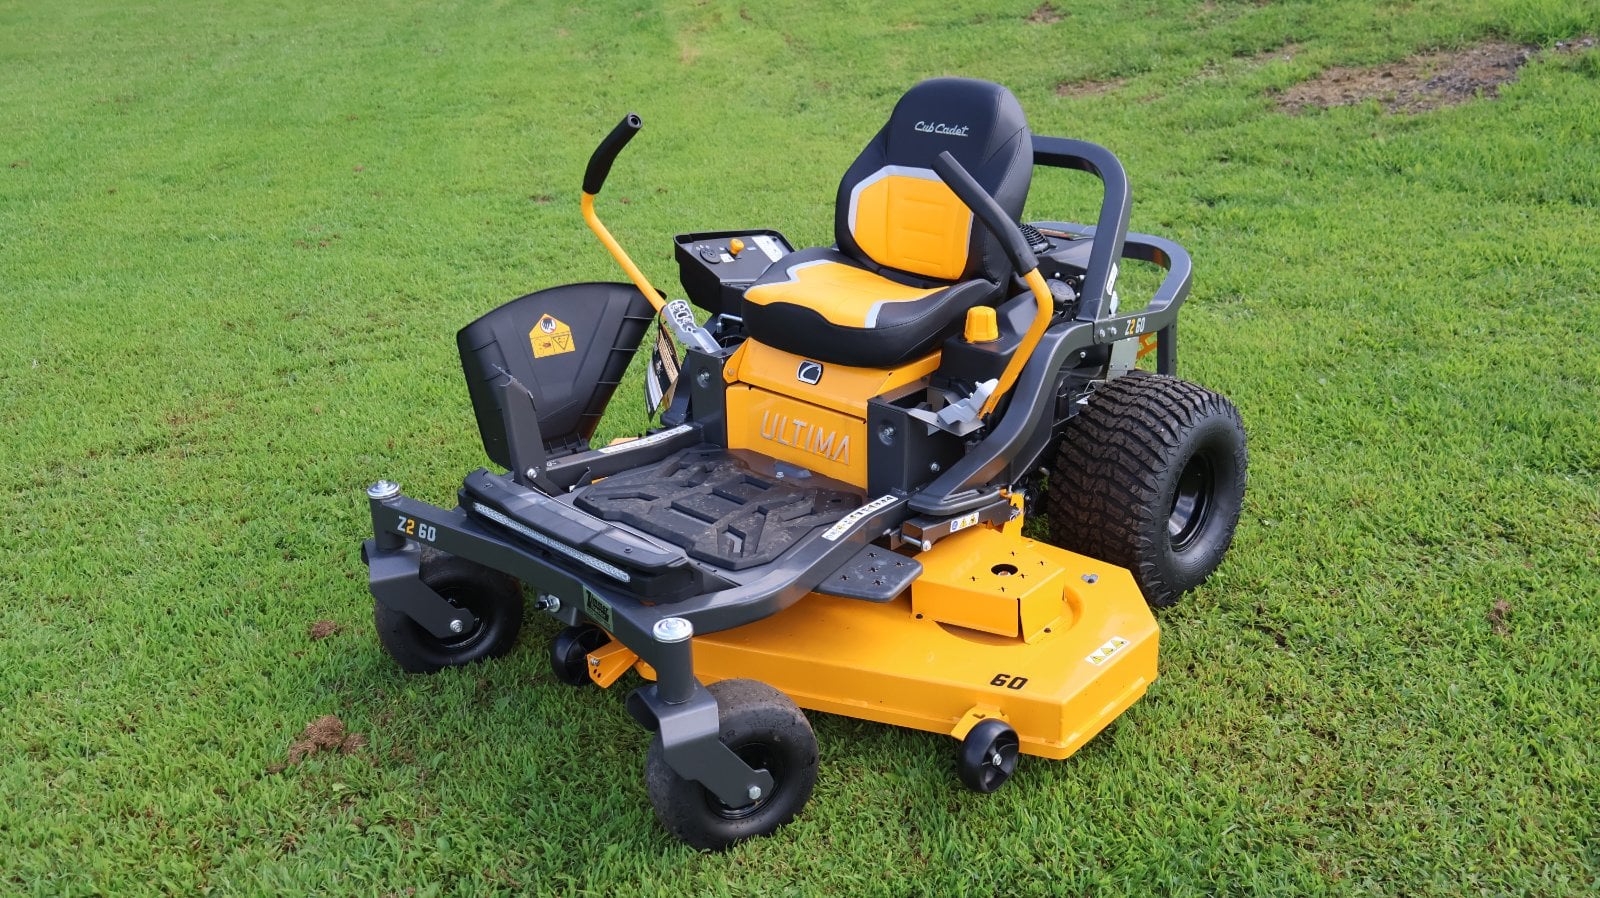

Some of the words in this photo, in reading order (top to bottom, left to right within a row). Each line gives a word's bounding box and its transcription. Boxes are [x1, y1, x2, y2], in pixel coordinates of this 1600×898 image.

[914, 121, 935, 133] Cub
[934, 123, 970, 137] Cadet
[1124, 318, 1136, 336] Z2
[1135, 317, 1146, 334] 60
[760, 410, 850, 465] ULTIMA
[397, 515, 415, 535] Z2
[418, 523, 437, 542] 60
[990, 673, 1029, 690] 60
